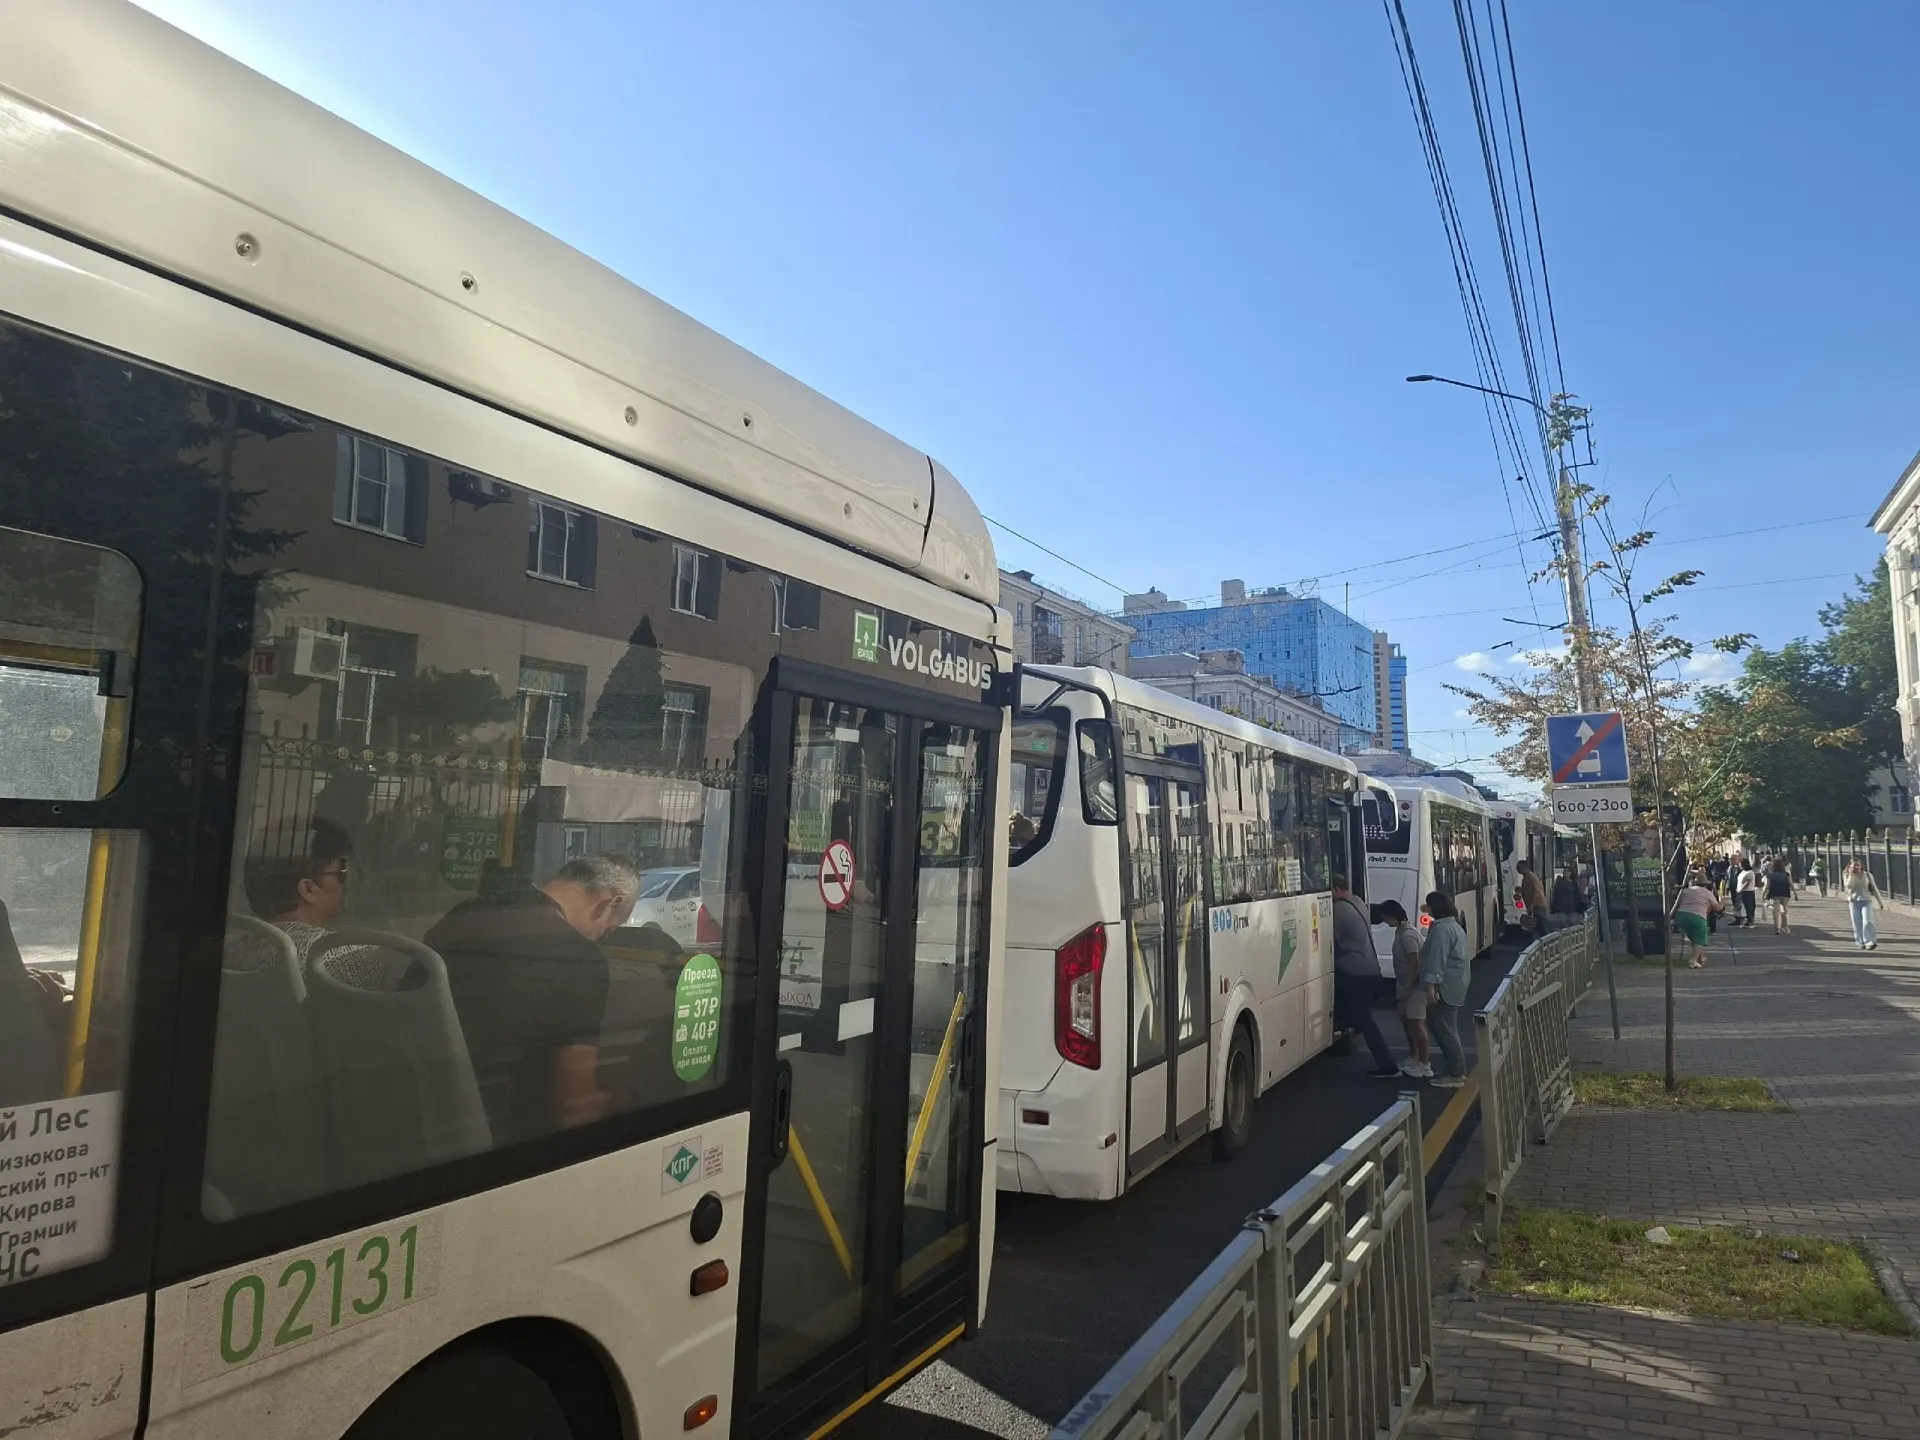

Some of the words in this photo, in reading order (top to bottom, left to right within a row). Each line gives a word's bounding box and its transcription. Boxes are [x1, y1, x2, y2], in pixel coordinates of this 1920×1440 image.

[857, 647, 874, 662] ВХОД
[888, 634, 992, 690] VOLGABUS
[1557, 798, 1629, 812] 6.00-23.00
[1389, 856, 1408, 864] 5292
[683, 968, 718, 984] Проезд
[693, 996, 719, 1018] 37₽
[780, 991, 814, 1009] ЫХОД
[691, 1020, 717, 1042] 40₽
[682, 1045, 708, 1057] Оплата
[676, 1058, 690, 1071] при
[691, 1054, 712, 1066] входе
[29, 1106, 91, 1138] Лес
[671, 1154, 694, 1176] КПГ
[0, 1170, 47, 1199] ский
[53, 1163, 111, 1189] пр-кт
[0, 1194, 77, 1224] Кирова
[219, 1224, 419, 1365] 02131
